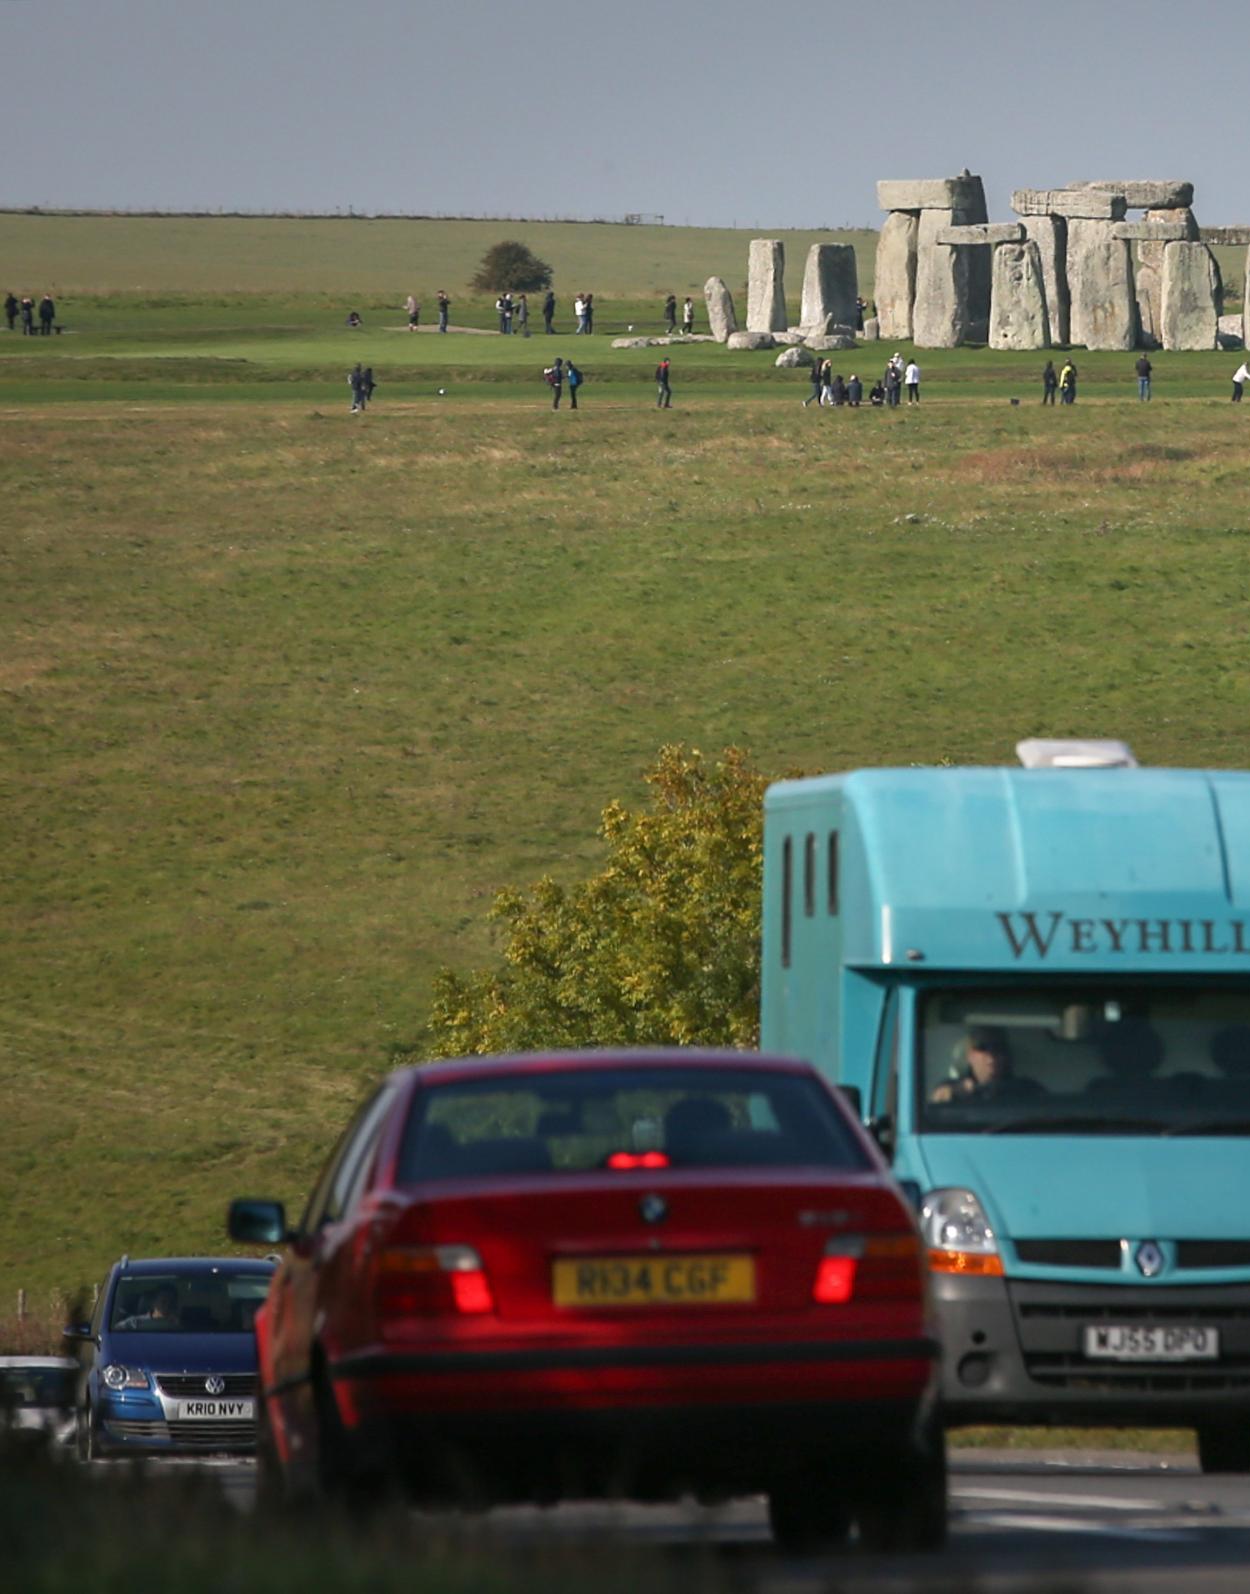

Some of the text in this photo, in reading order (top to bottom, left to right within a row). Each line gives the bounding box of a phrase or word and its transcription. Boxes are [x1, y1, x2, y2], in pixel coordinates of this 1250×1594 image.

[576, 1260, 730, 1298] R134 CGF
[187, 1402, 244, 1415] KR10 NVY
